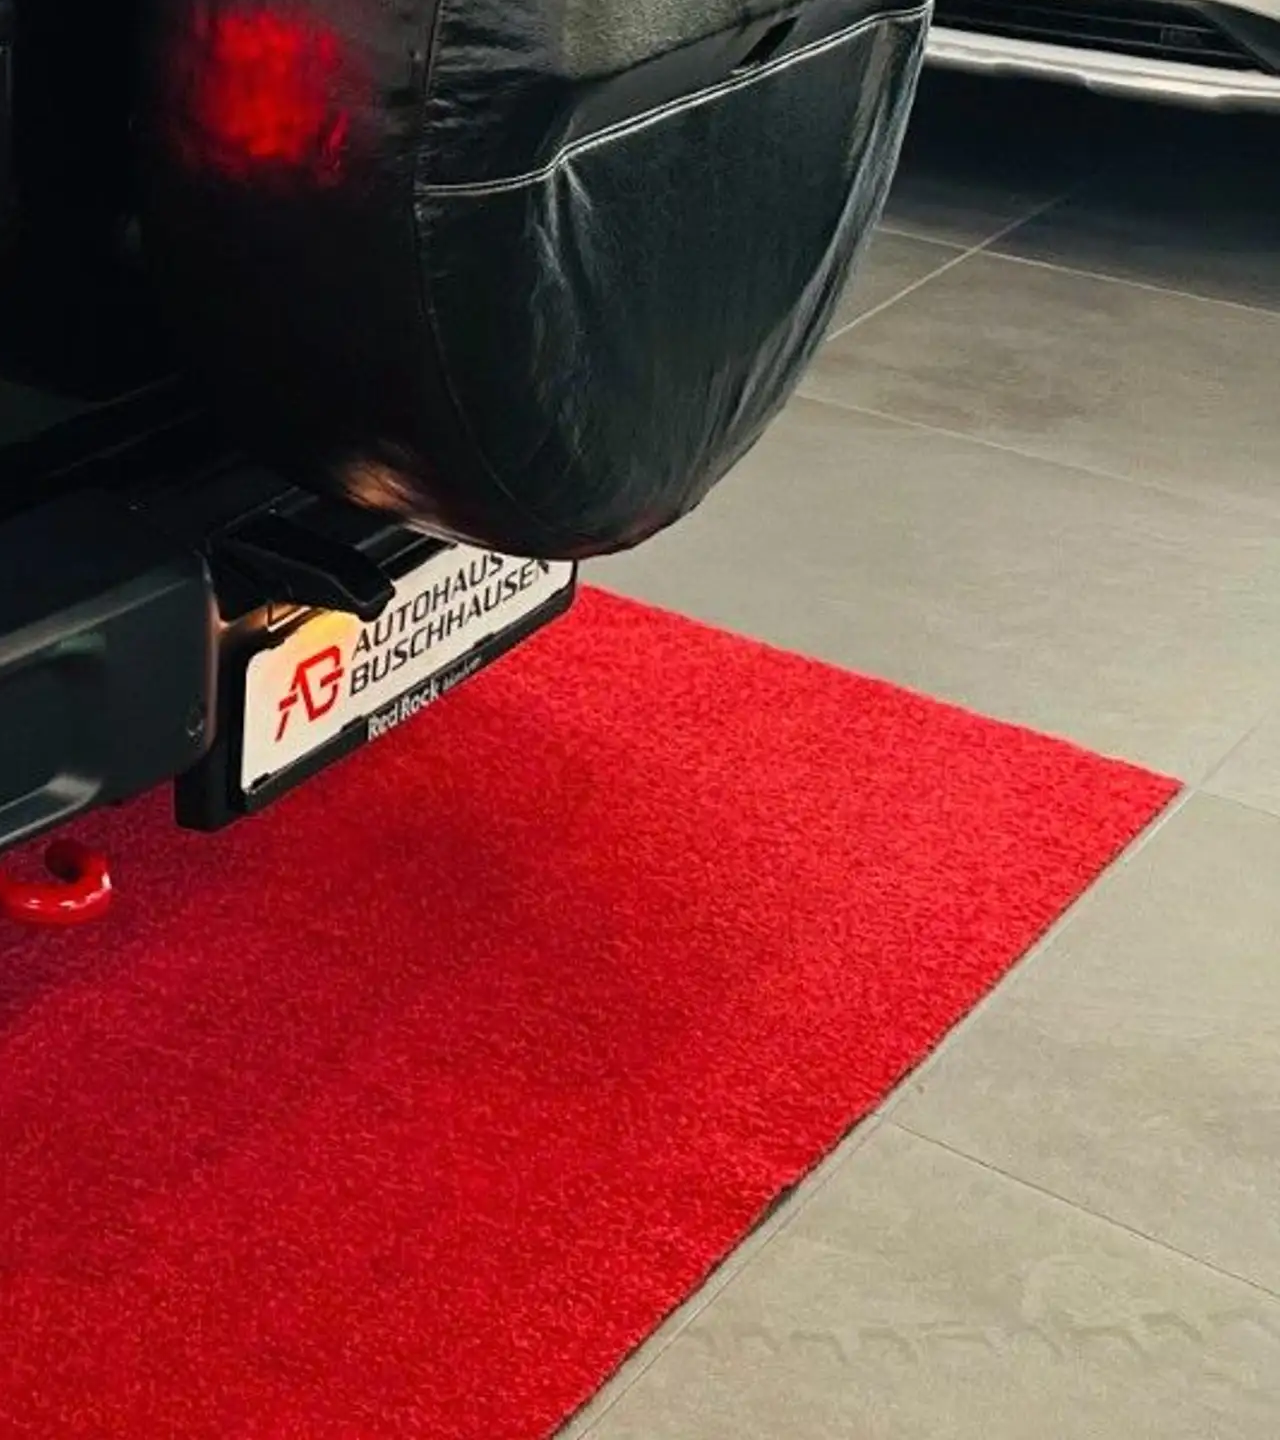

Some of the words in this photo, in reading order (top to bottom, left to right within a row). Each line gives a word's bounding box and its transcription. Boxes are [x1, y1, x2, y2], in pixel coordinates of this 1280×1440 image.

[349, 558, 550, 697] BUSCHHAUSEN
[351, 551, 504, 661] AUTOHAUS
[367, 702, 400, 743] Red
[400, 678, 439, 722] Rock
